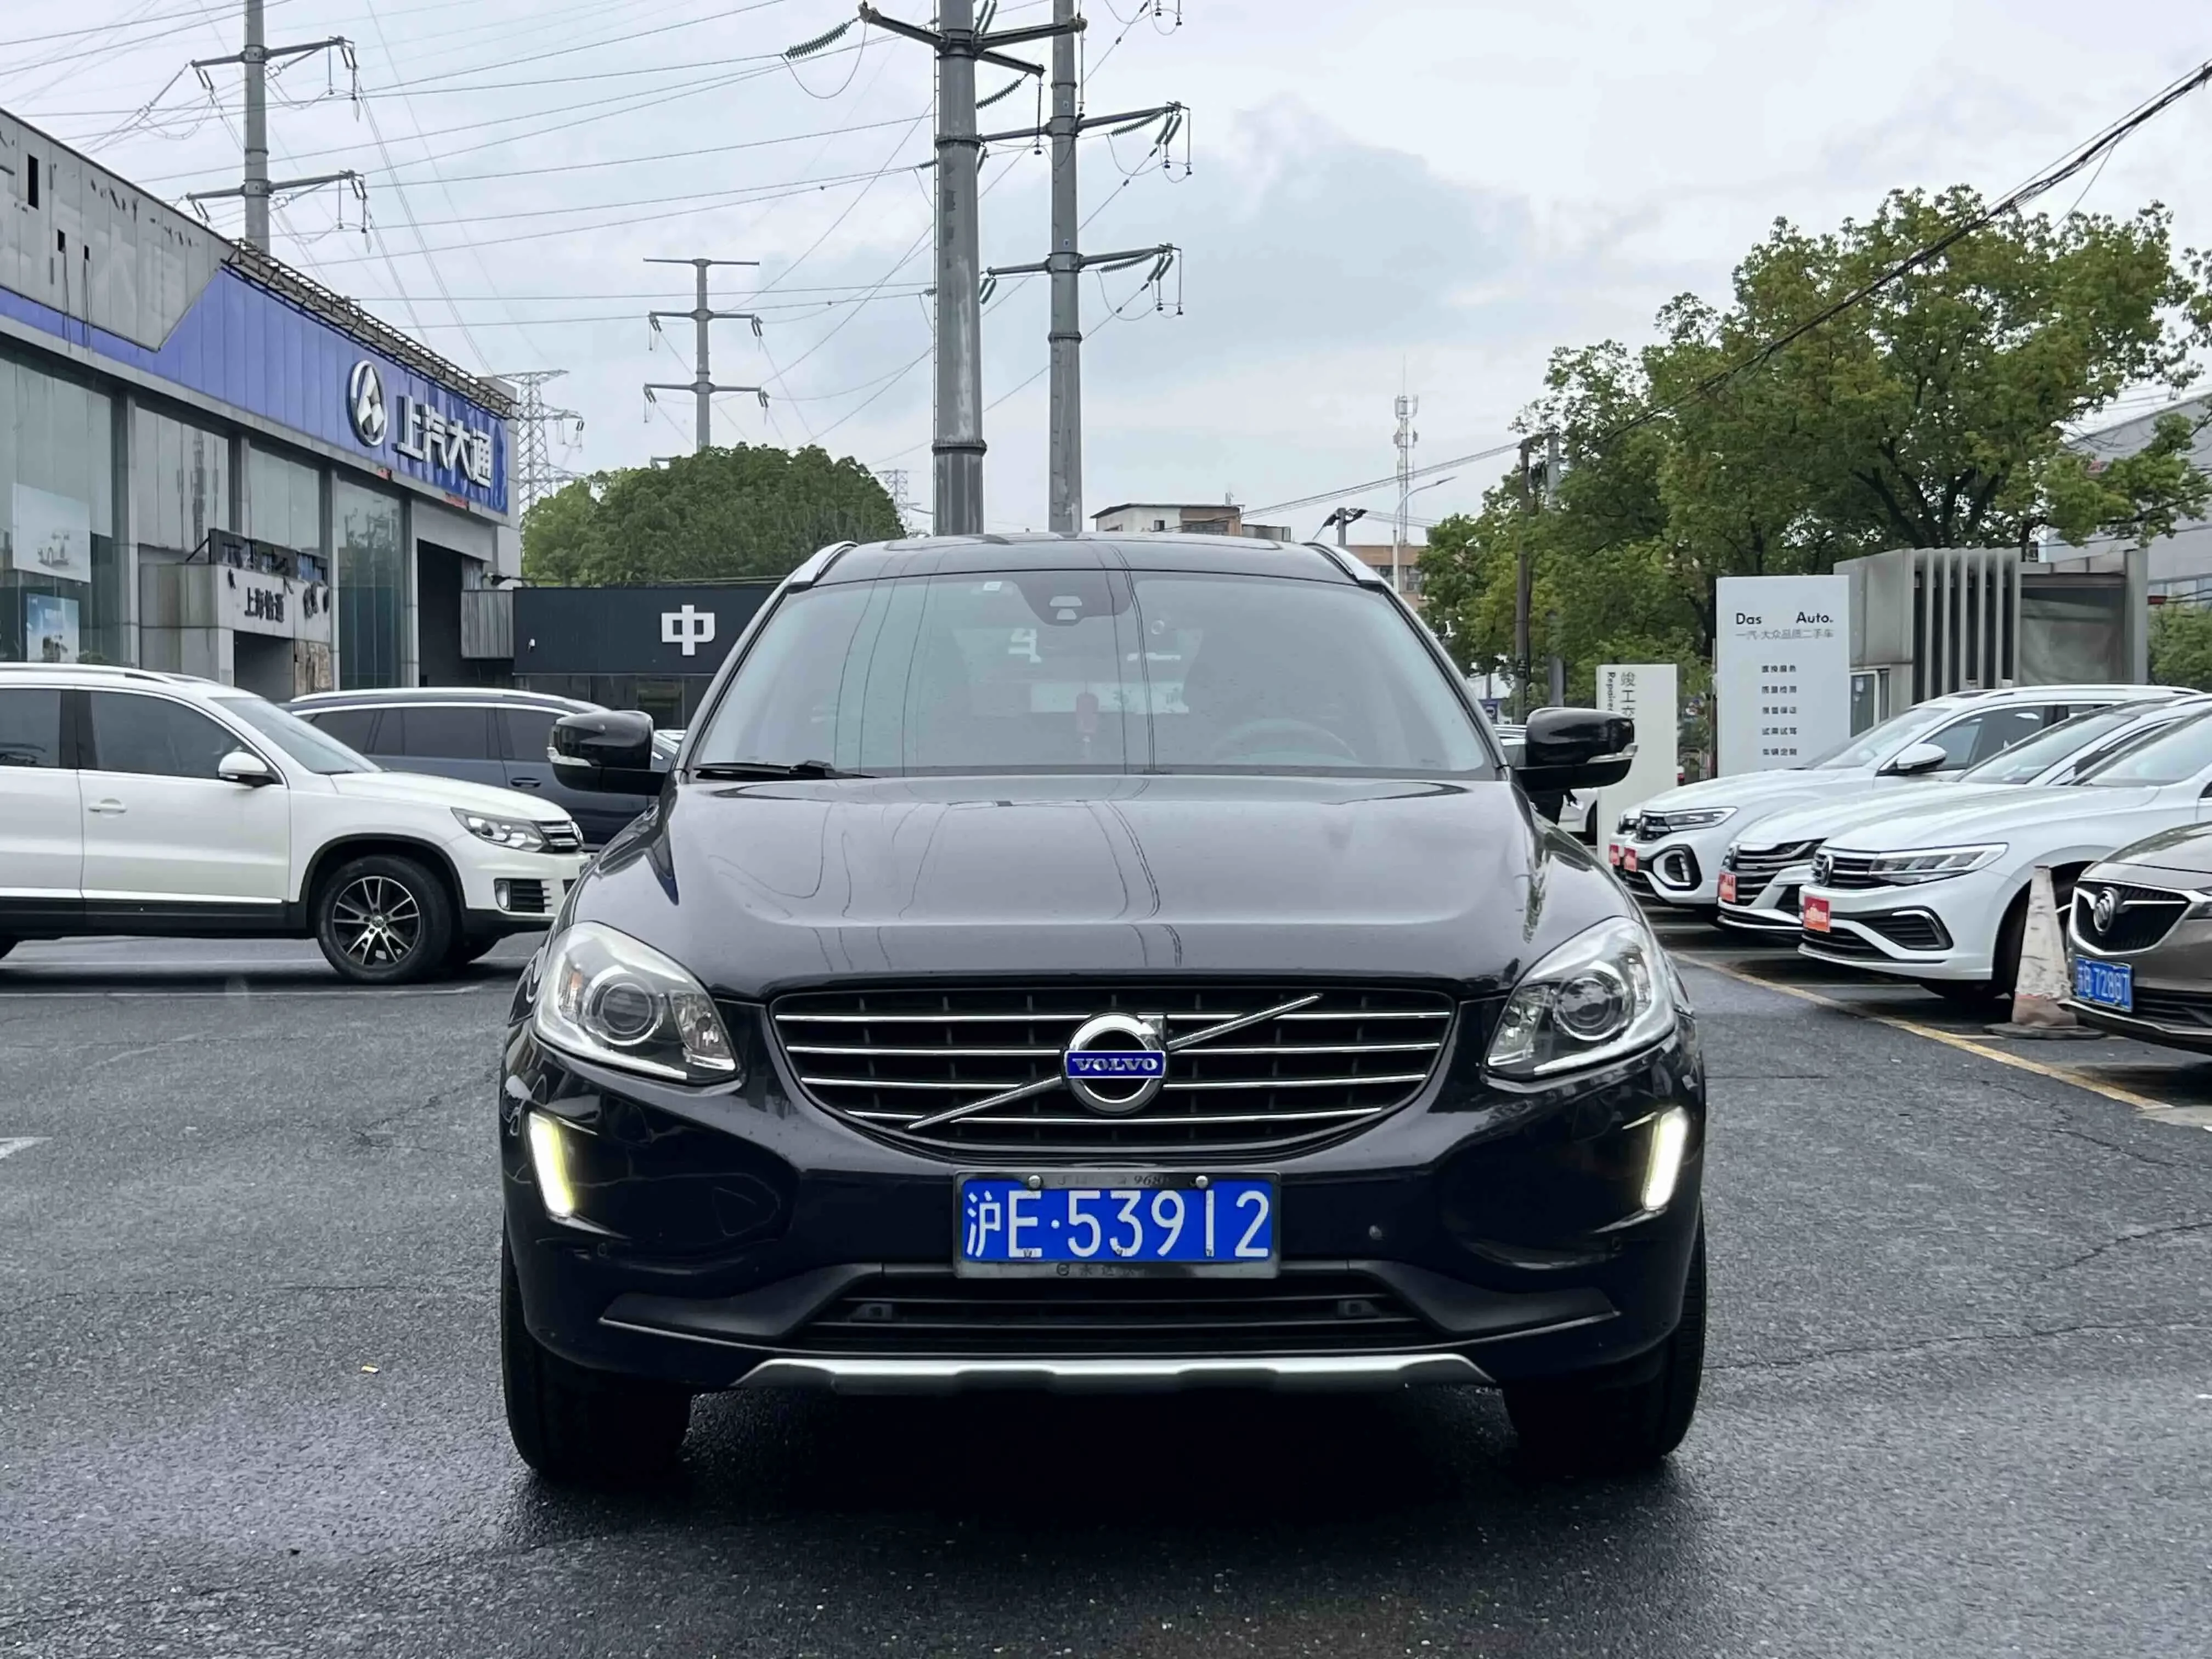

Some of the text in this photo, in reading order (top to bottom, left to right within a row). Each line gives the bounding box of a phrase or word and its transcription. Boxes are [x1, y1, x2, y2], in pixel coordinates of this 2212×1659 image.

[393, 394, 492, 488] 上汽大通
[661, 604, 715, 656] 中
[1735, 612, 1834, 625] Das Auto.
[1071, 1058, 1158, 1071] VOLVO
[966, 1189, 1270, 1257] 沪E·53912
